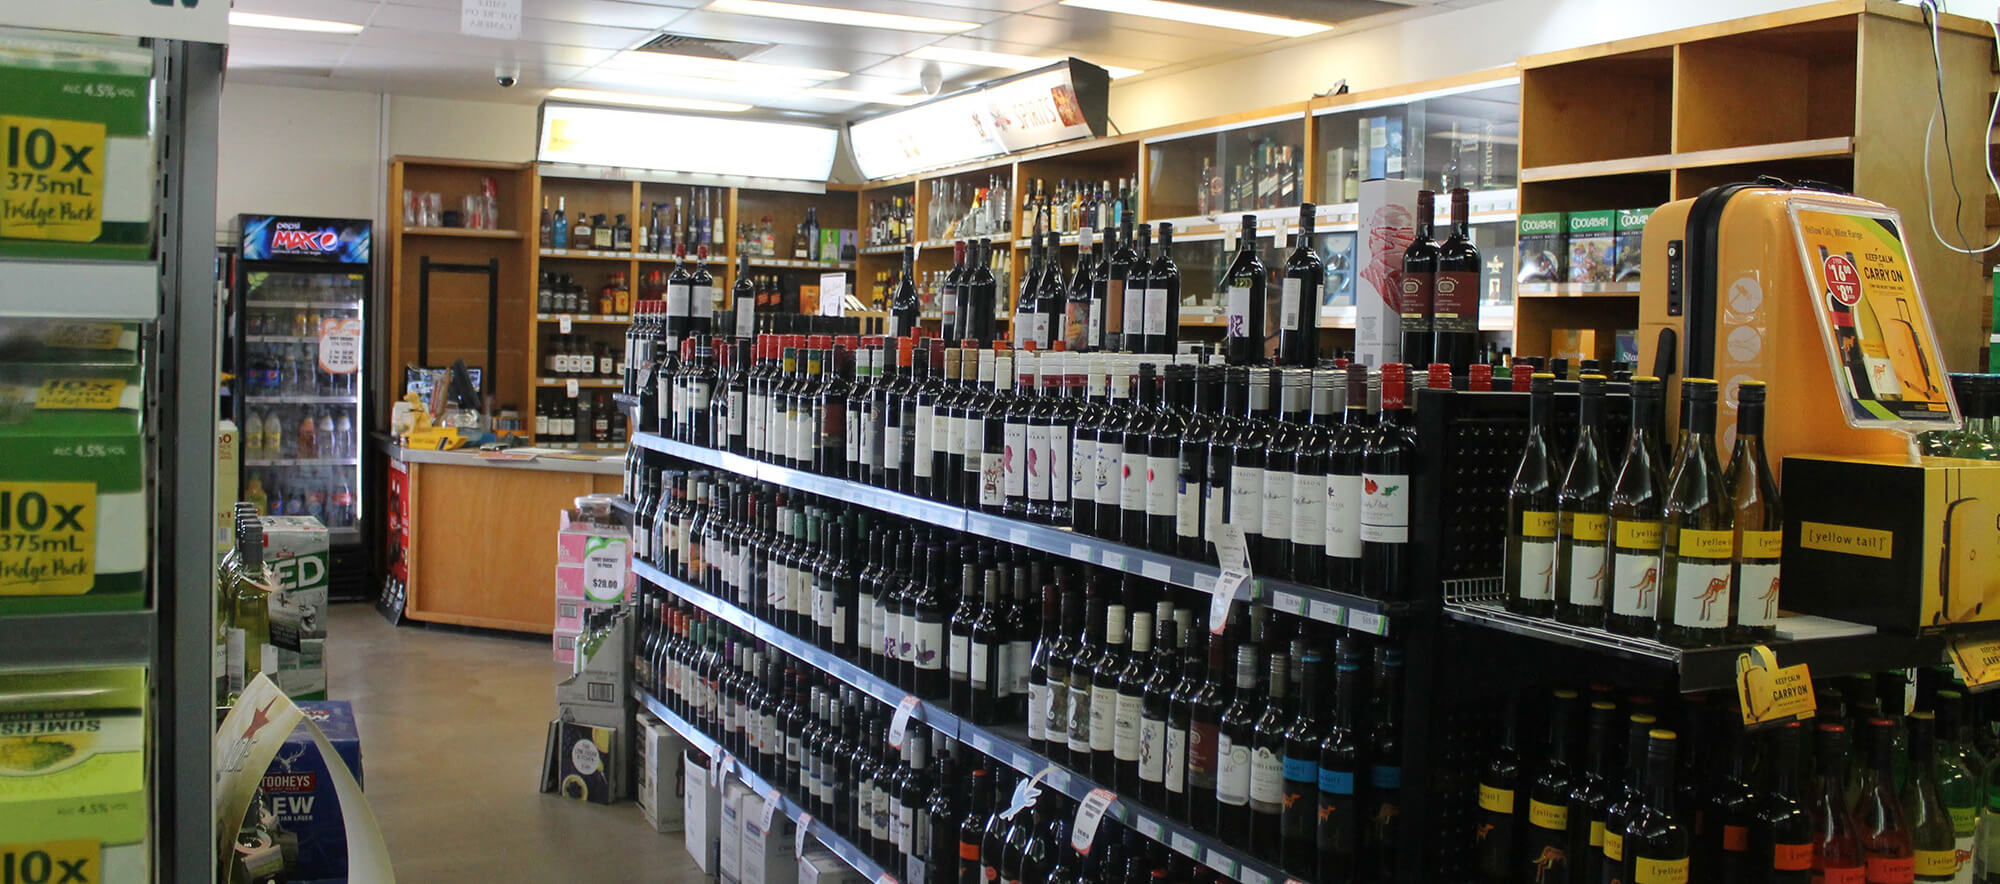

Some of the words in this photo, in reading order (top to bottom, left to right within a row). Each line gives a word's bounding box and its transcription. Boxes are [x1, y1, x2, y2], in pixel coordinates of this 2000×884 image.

[7, 125, 94, 175] 10x
[6, 172, 92, 196] 375mL
[59, 201, 95, 222] Pack
[276, 222, 301, 231] pepsi
[1521, 219, 1556, 232] COOLABAH
[1571, 217, 1609, 230] COOLABAH
[271, 231, 322, 250] MAX
[1865, 253, 1878, 262] KEEP
[1864, 266, 1890, 281] CARRY
[1890, 269, 1904, 282] ON
[0, 491, 86, 532] 10x
[0, 533, 85, 553] 375mL
[52, 558, 88, 577] Pack
[270, 555, 326, 590] ED
[1775, 678, 1788, 686] KEEP
[1773, 687, 1797, 702] CARRY
[1797, 684, 1809, 695] ON
[261, 775, 311, 788] TOOHEYS
[272, 796, 315, 814] EW
[2, 850, 90, 884] 10x
